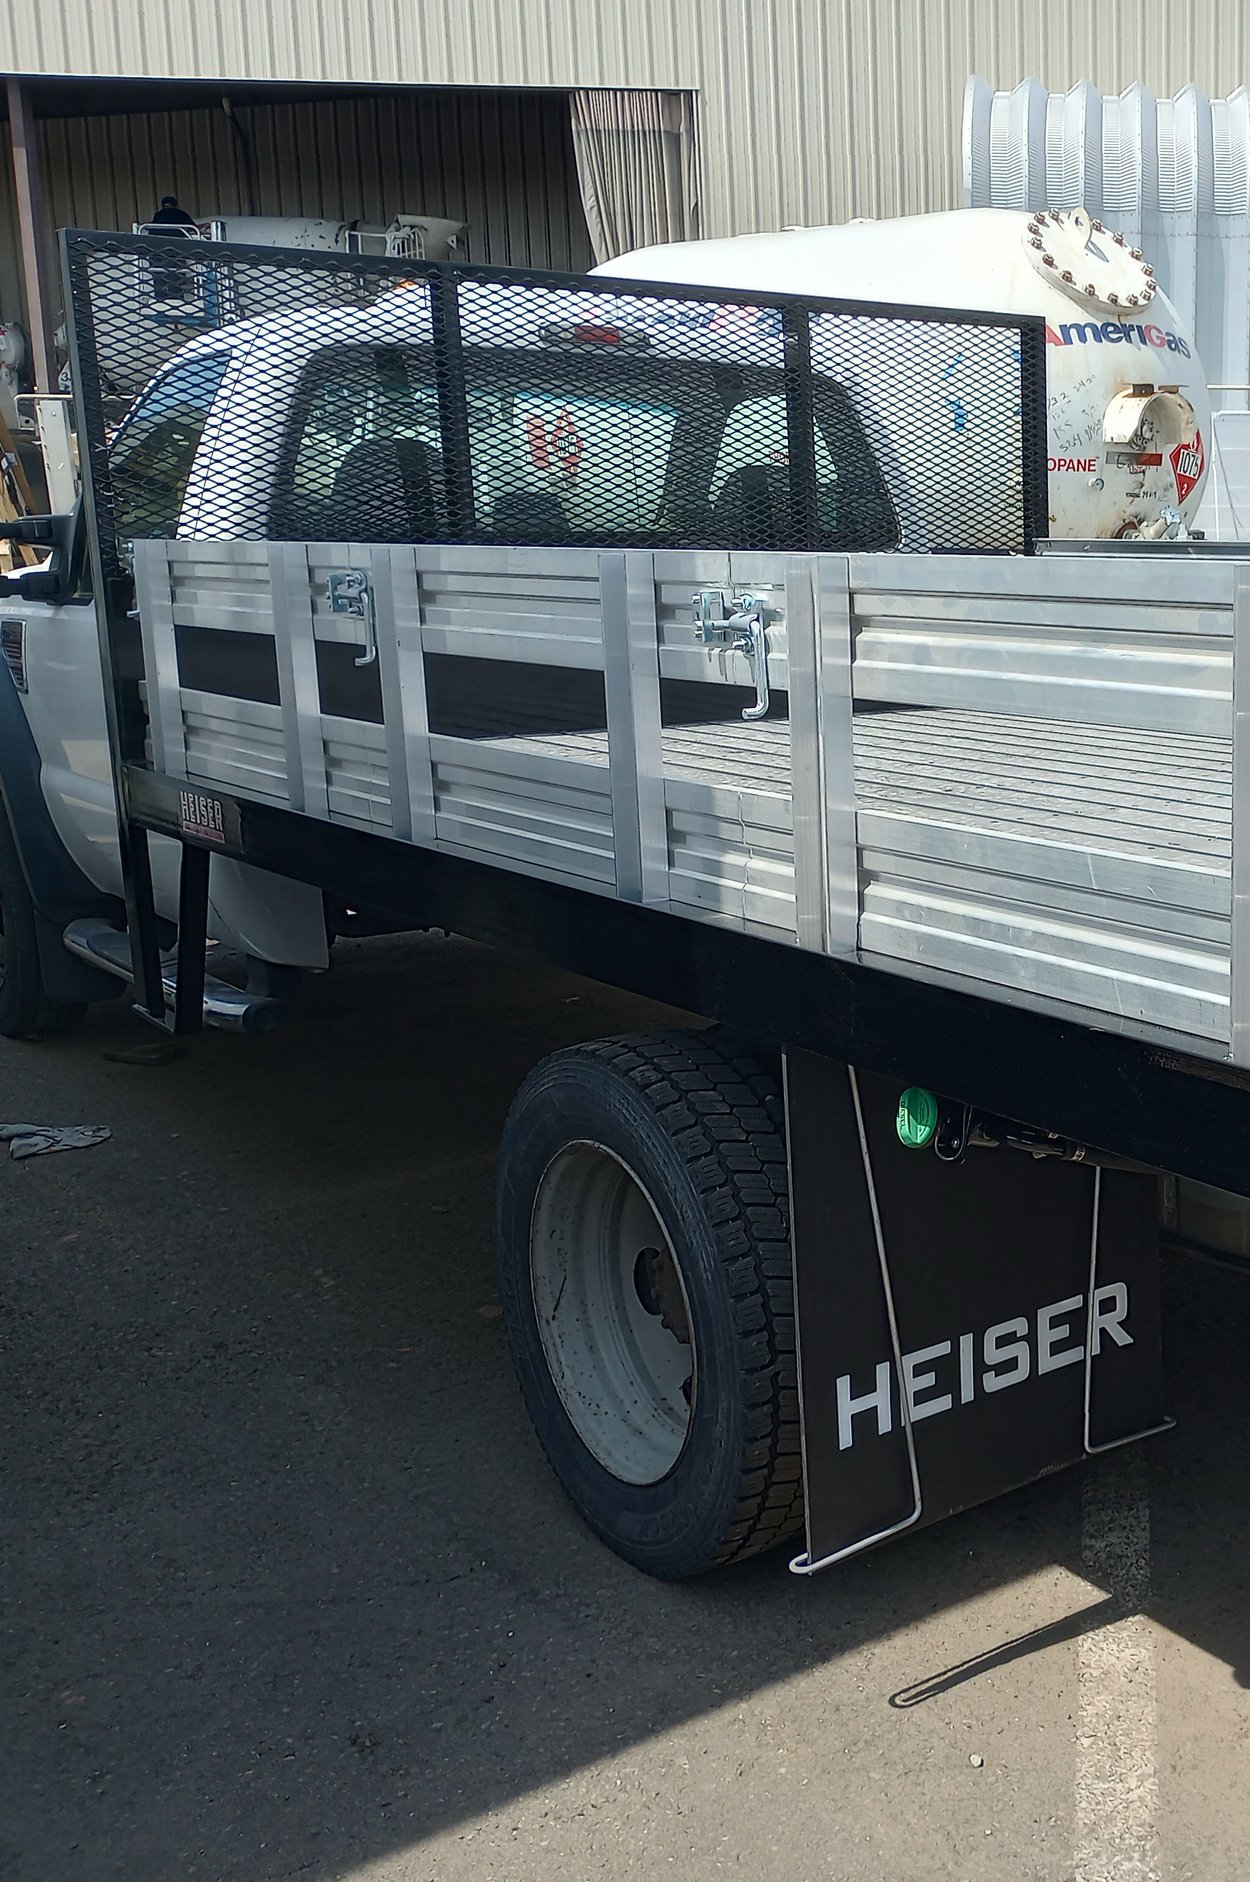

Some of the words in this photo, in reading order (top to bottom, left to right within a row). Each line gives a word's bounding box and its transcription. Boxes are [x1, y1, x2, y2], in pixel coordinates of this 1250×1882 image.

[1046, 457, 1097, 473] OPANE
[1178, 450, 1200, 477] 1075
[1181, 483, 1188, 495] 2
[180, 790, 223, 831] HEISER
[836, 1282, 1134, 1451] HEISER
